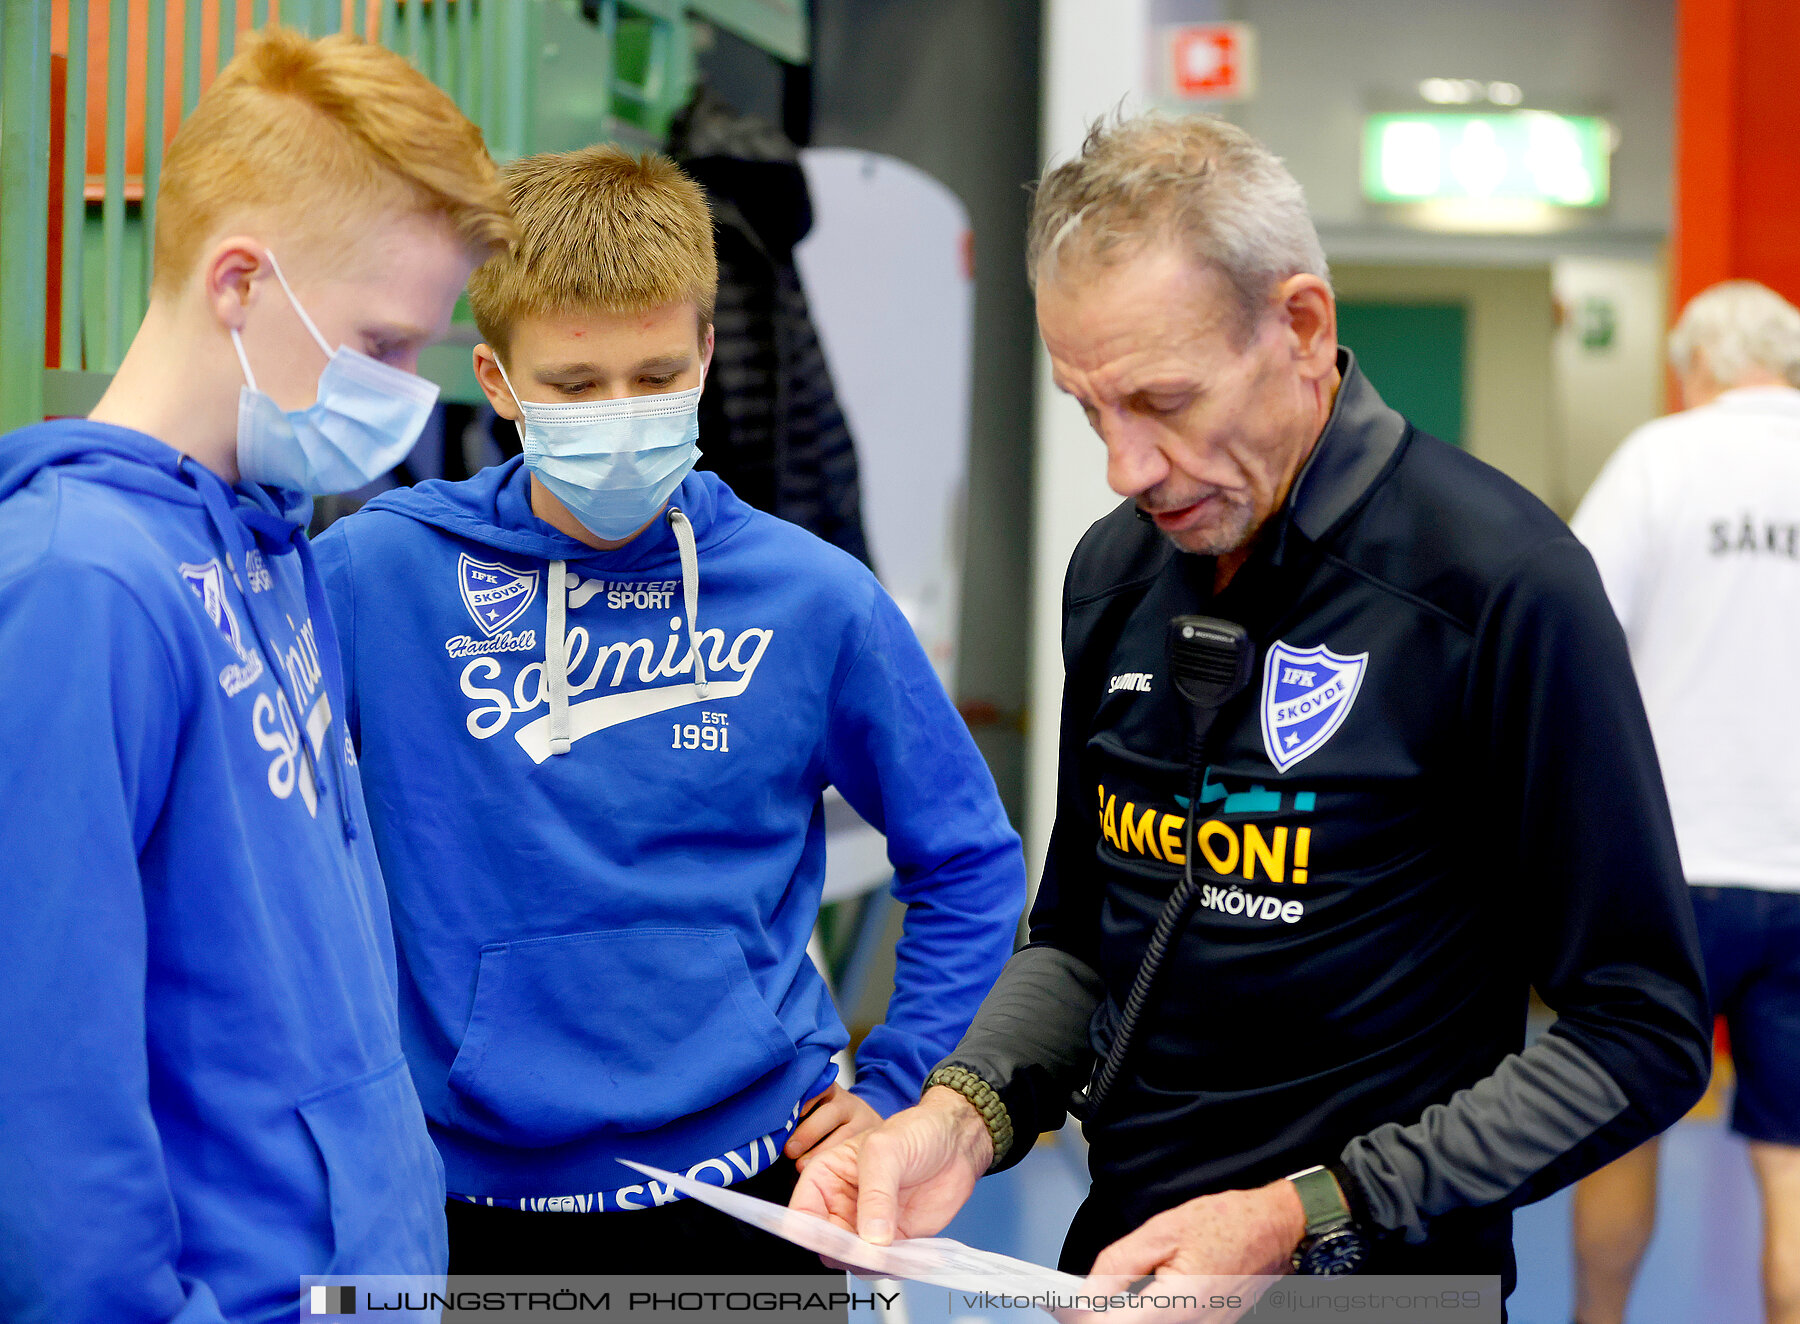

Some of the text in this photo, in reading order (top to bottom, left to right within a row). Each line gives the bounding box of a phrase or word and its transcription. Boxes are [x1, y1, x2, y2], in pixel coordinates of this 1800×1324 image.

[471, 570, 499, 585] IFK
[474, 582, 525, 603] SKÖVDE
[607, 590, 675, 610] SPORT
[445, 629, 536, 658] Handboll
[459, 616, 774, 740] Salming
[1281, 667, 1318, 688] IFK
[702, 711, 729, 726] EST.
[671, 723, 729, 753] 1991
[1197, 819, 1312, 885] ON!
